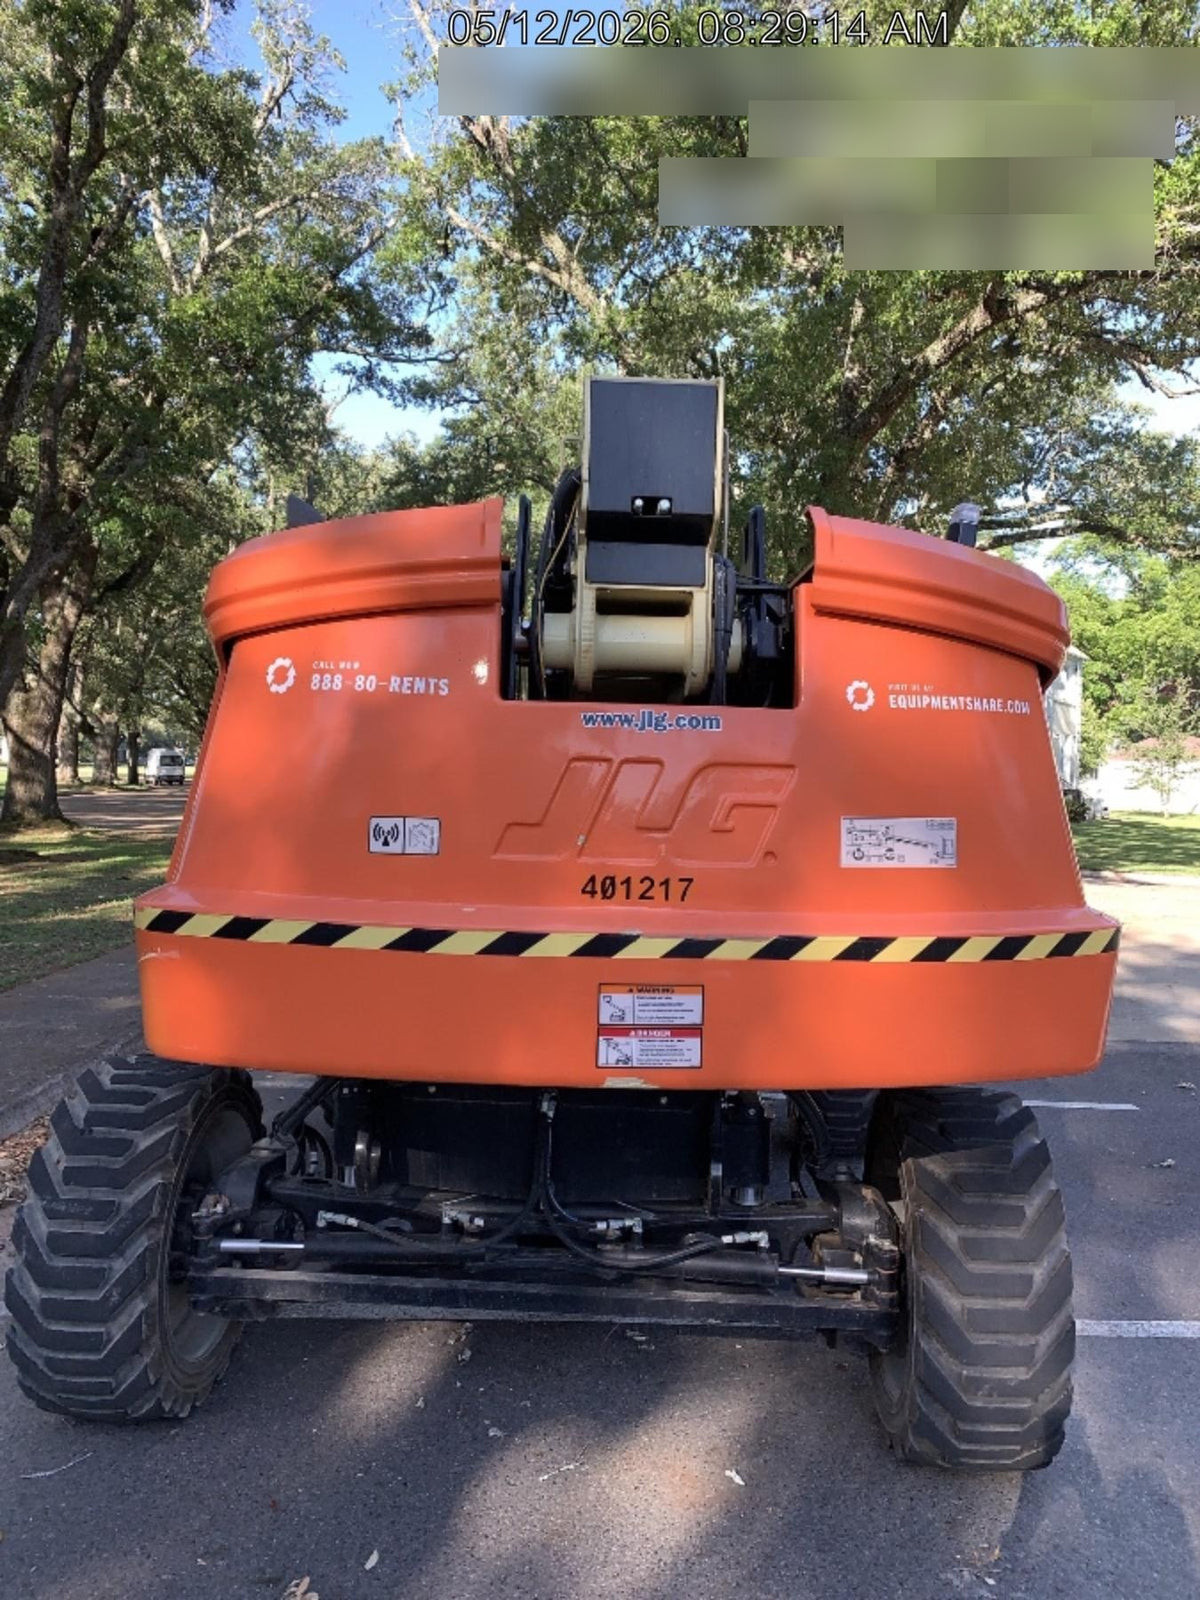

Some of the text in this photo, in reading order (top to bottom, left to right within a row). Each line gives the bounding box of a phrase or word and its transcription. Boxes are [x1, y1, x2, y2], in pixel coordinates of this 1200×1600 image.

[888, 694, 1030, 715] EQUIPMENTSHARE.COM
[581, 710, 722, 731] www.jlg.com
[490, 756, 799, 868] JLG
[580, 875, 694, 902] 401217
